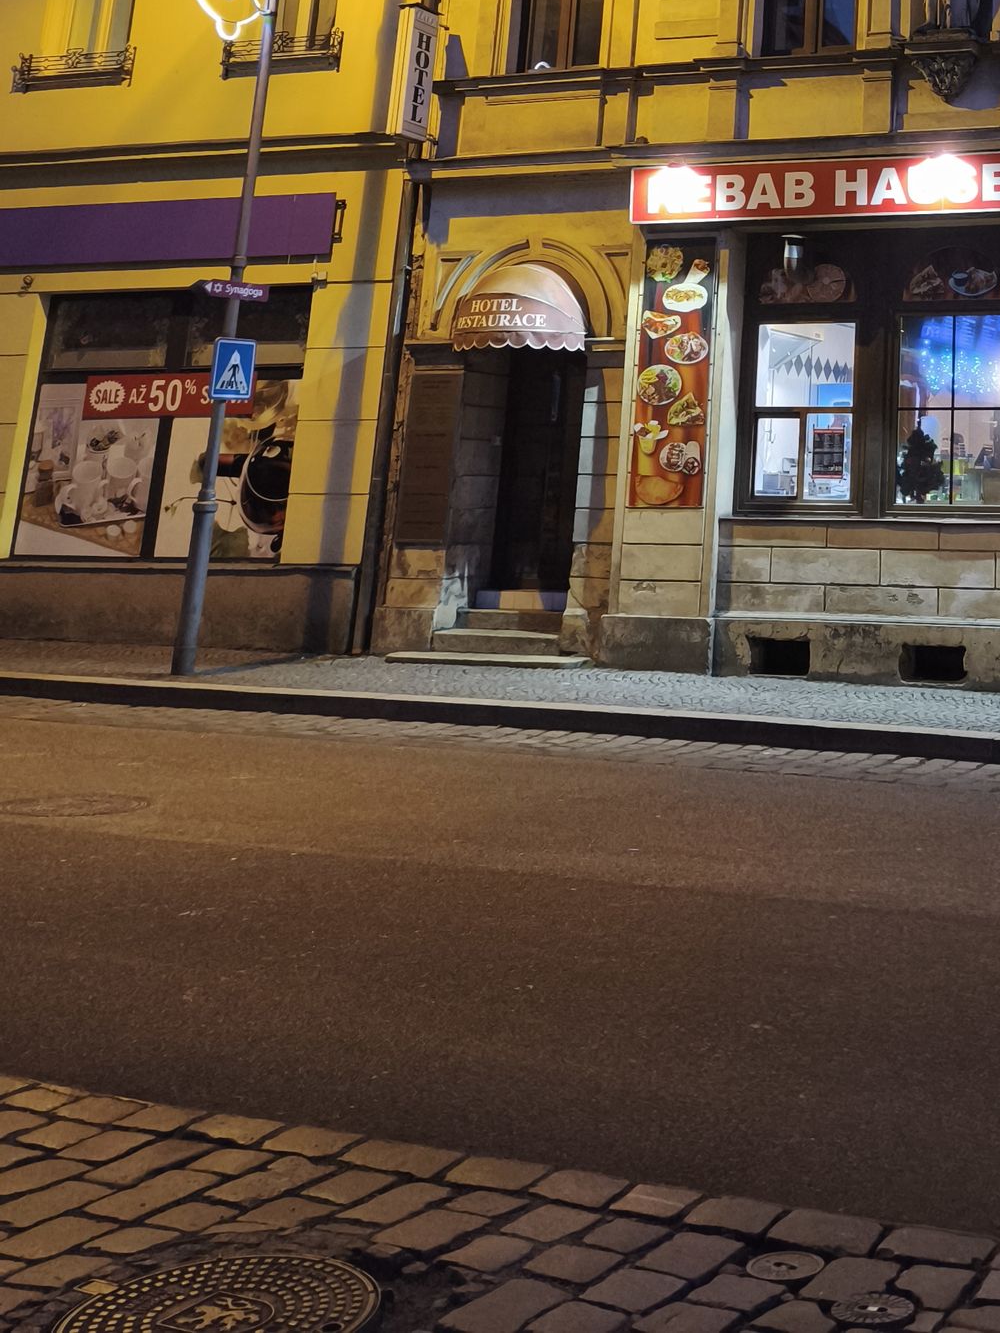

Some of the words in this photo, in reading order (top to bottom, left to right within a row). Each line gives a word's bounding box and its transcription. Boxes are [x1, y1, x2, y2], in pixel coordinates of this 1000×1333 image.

[411, 32, 432, 123] HOTEL
[225, 283, 263, 298] Synagoga
[470, 298, 523, 313] HOTEL
[94, 387, 121, 405] SALE
[128, 384, 148, 405] AŽ
